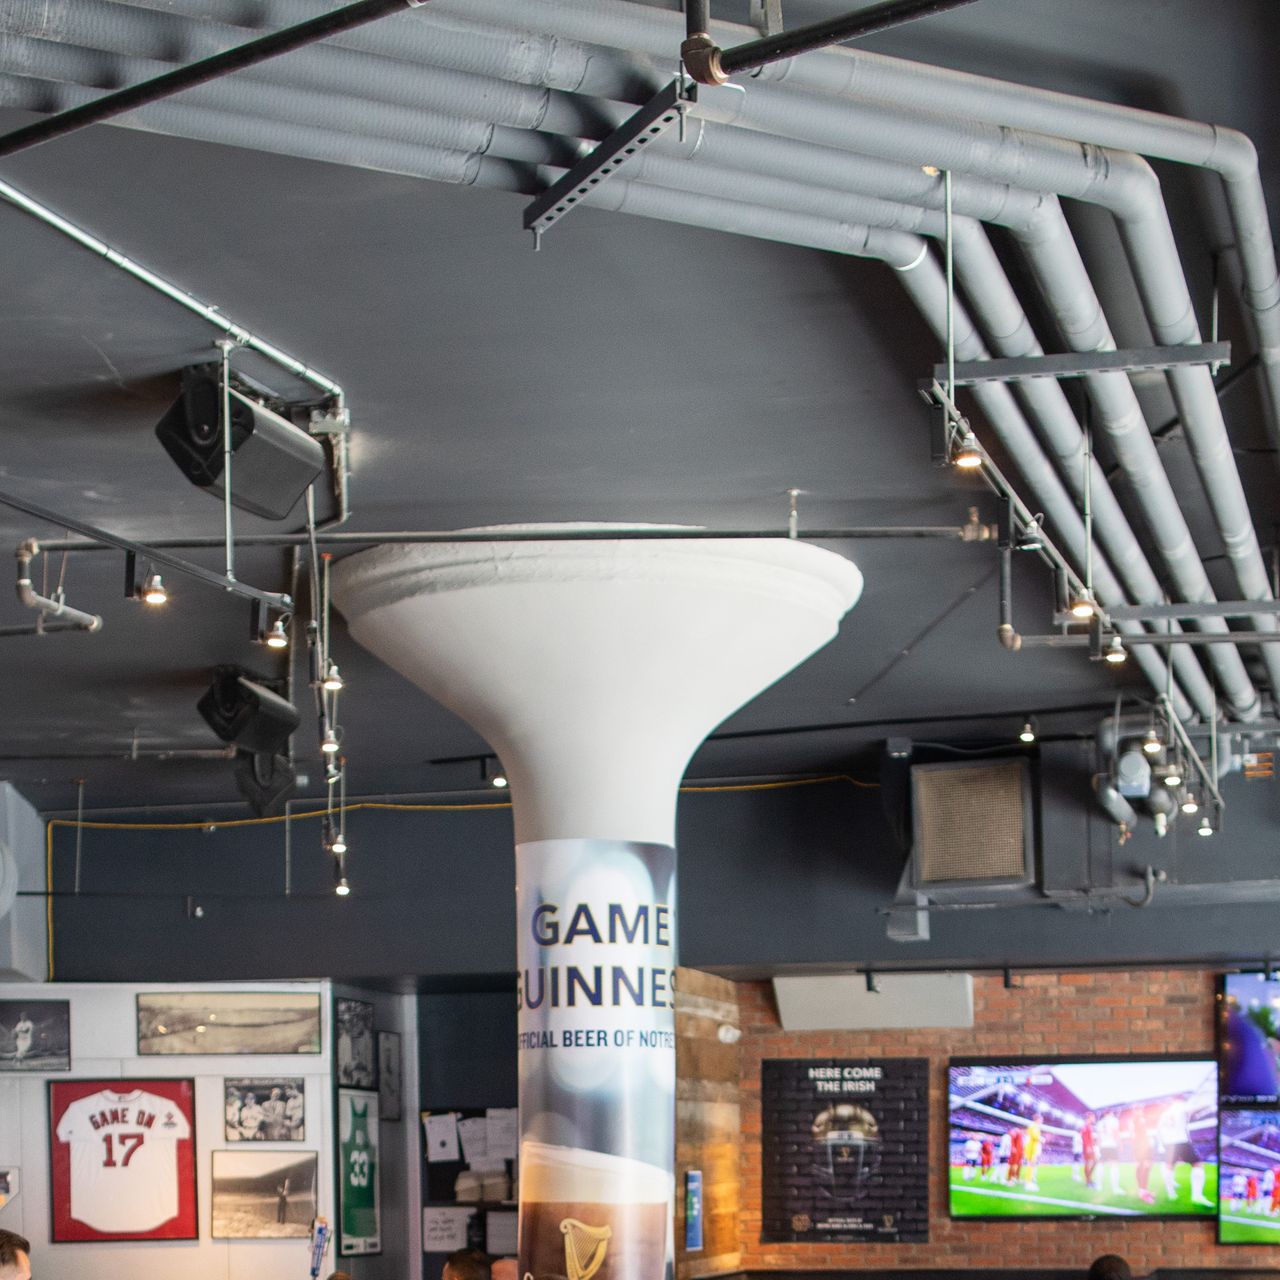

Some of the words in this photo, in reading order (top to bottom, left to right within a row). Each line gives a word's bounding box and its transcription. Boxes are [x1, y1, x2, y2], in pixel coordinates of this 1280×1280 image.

[532, 903, 670, 947] GAME
[562, 1029, 608, 1048] BEER
[613, 1030, 635, 1047] OF
[808, 1067, 841, 1079] HERE
[843, 1067, 882, 1079] COME
[816, 1080, 840, 1093] THE
[842, 1080, 876, 1093] IRISH
[89, 1107, 130, 1131] GAME
[136, 1109, 156, 1130] ON
[102, 1133, 144, 1168] 17
[349, 1150, 369, 1188] 33
